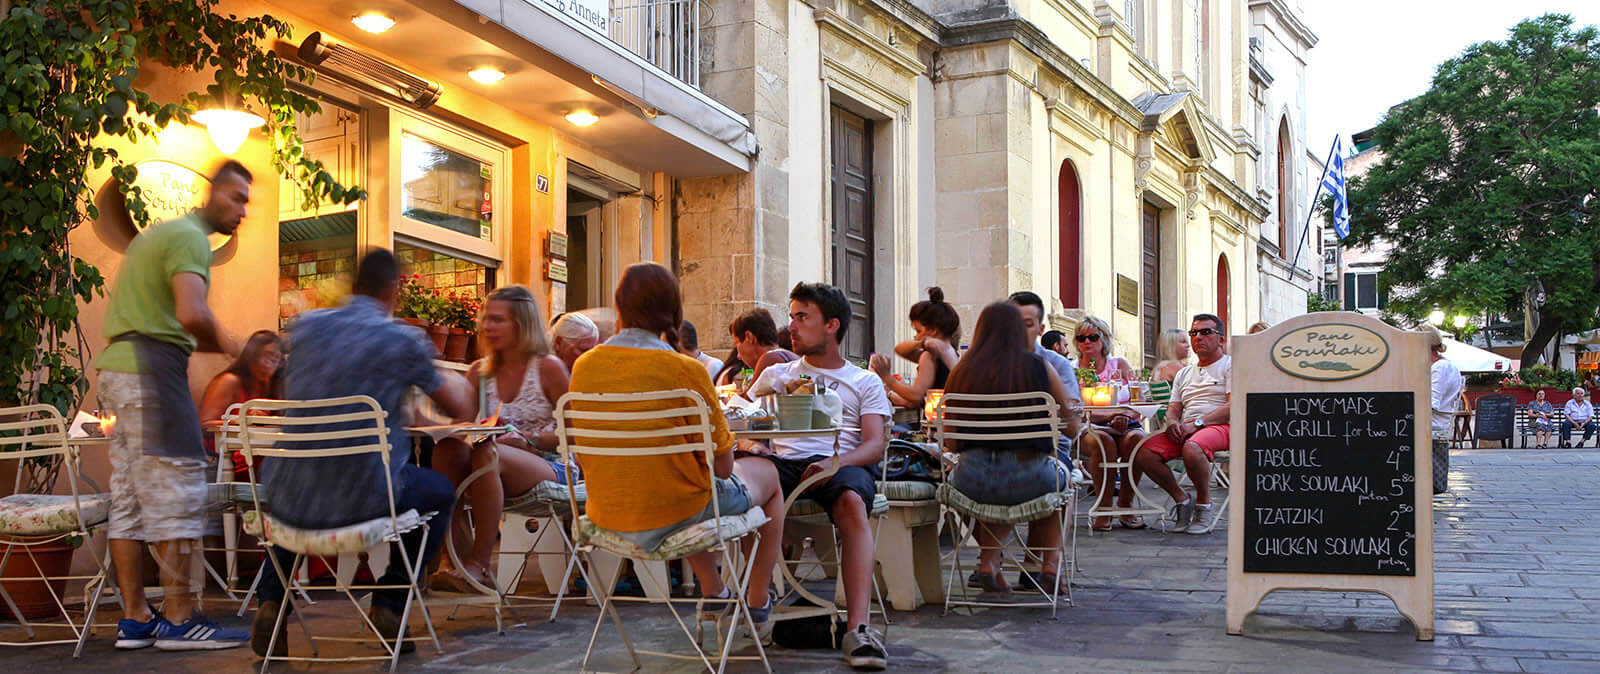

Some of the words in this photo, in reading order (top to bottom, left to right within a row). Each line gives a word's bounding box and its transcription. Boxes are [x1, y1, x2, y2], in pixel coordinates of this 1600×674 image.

[1306, 332, 1354, 343] Pane
[1280, 343, 1378, 358] Souvlaki
[1285, 397, 1378, 415] HOMEMADE
[1255, 420, 1282, 439] MIX
[1287, 420, 1336, 438] GRILL
[1343, 420, 1363, 446] for
[1367, 420, 1388, 438] two
[1253, 448, 1322, 467] TABOULE
[1256, 473, 1294, 492] PORK
[1300, 475, 1368, 494] SOUVLAKI
[1255, 507, 1323, 525] TZATZIKI
[1255, 536, 1318, 555] CHICKEN
[1324, 536, 1391, 555] SOUVLAKI
